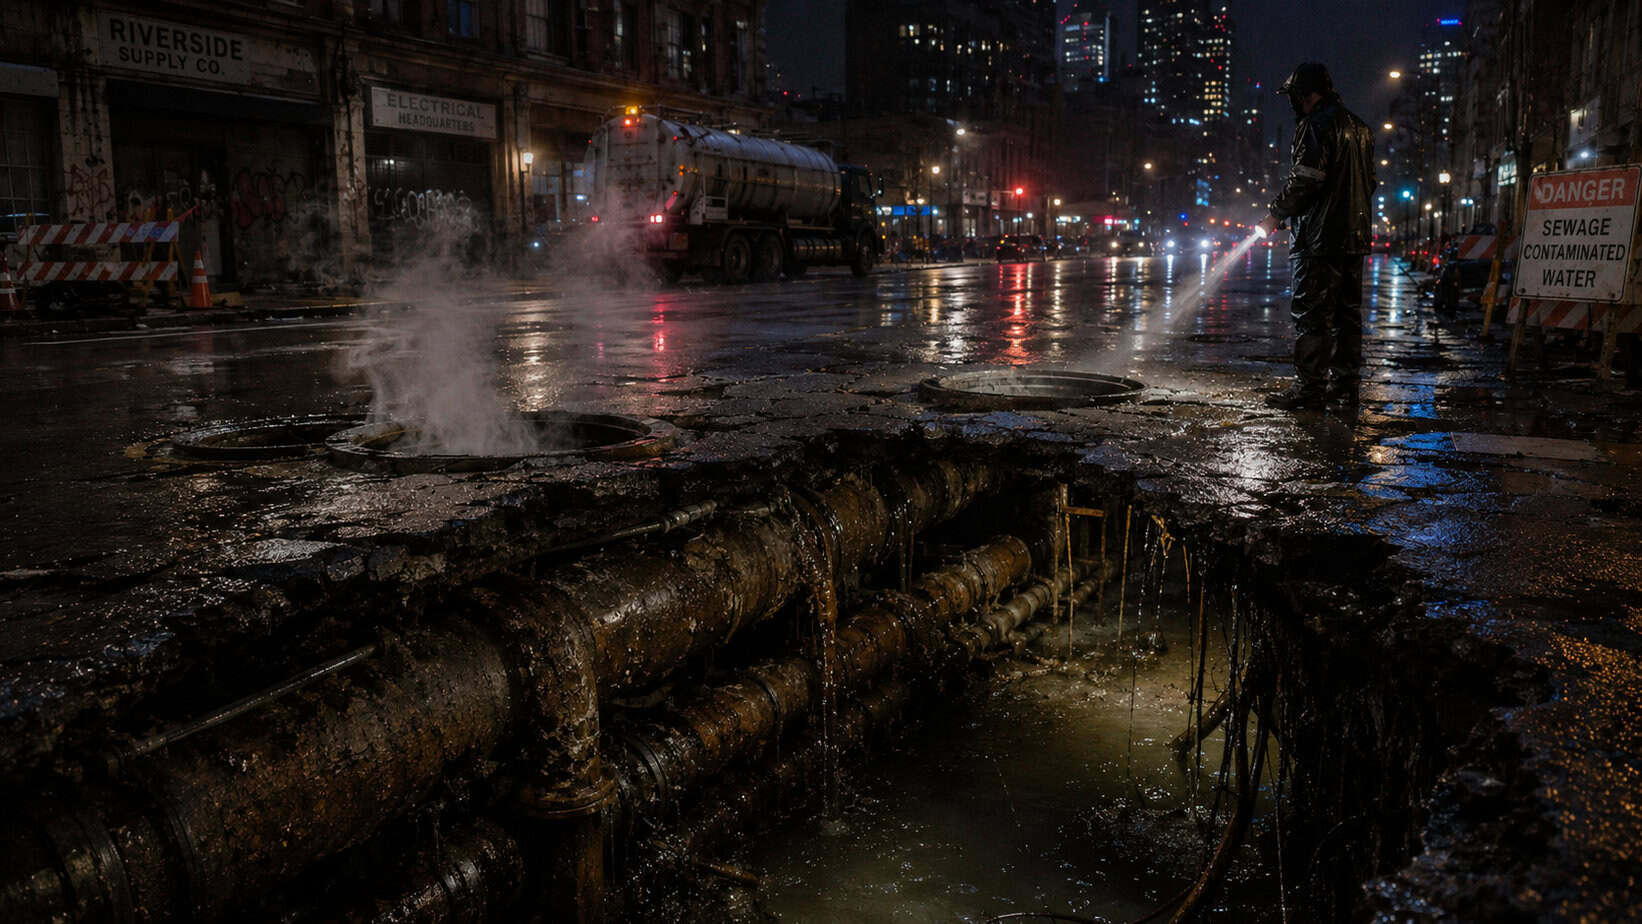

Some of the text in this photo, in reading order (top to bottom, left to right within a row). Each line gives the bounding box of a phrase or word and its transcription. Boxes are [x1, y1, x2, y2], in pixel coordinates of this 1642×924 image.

[110, 18, 242, 61] RIVERSIDE
[119, 46, 225, 76] SUPPLY CO.
[387, 93, 484, 119] ELECTRICAL
[398, 111, 473, 132] HEADQUARTERS
[1539, 177, 1625, 204] DANGER
[1542, 218, 1613, 236] SEWAGE
[1523, 244, 1626, 261] CONTAMINATED
[1543, 269, 1597, 288] WATER
